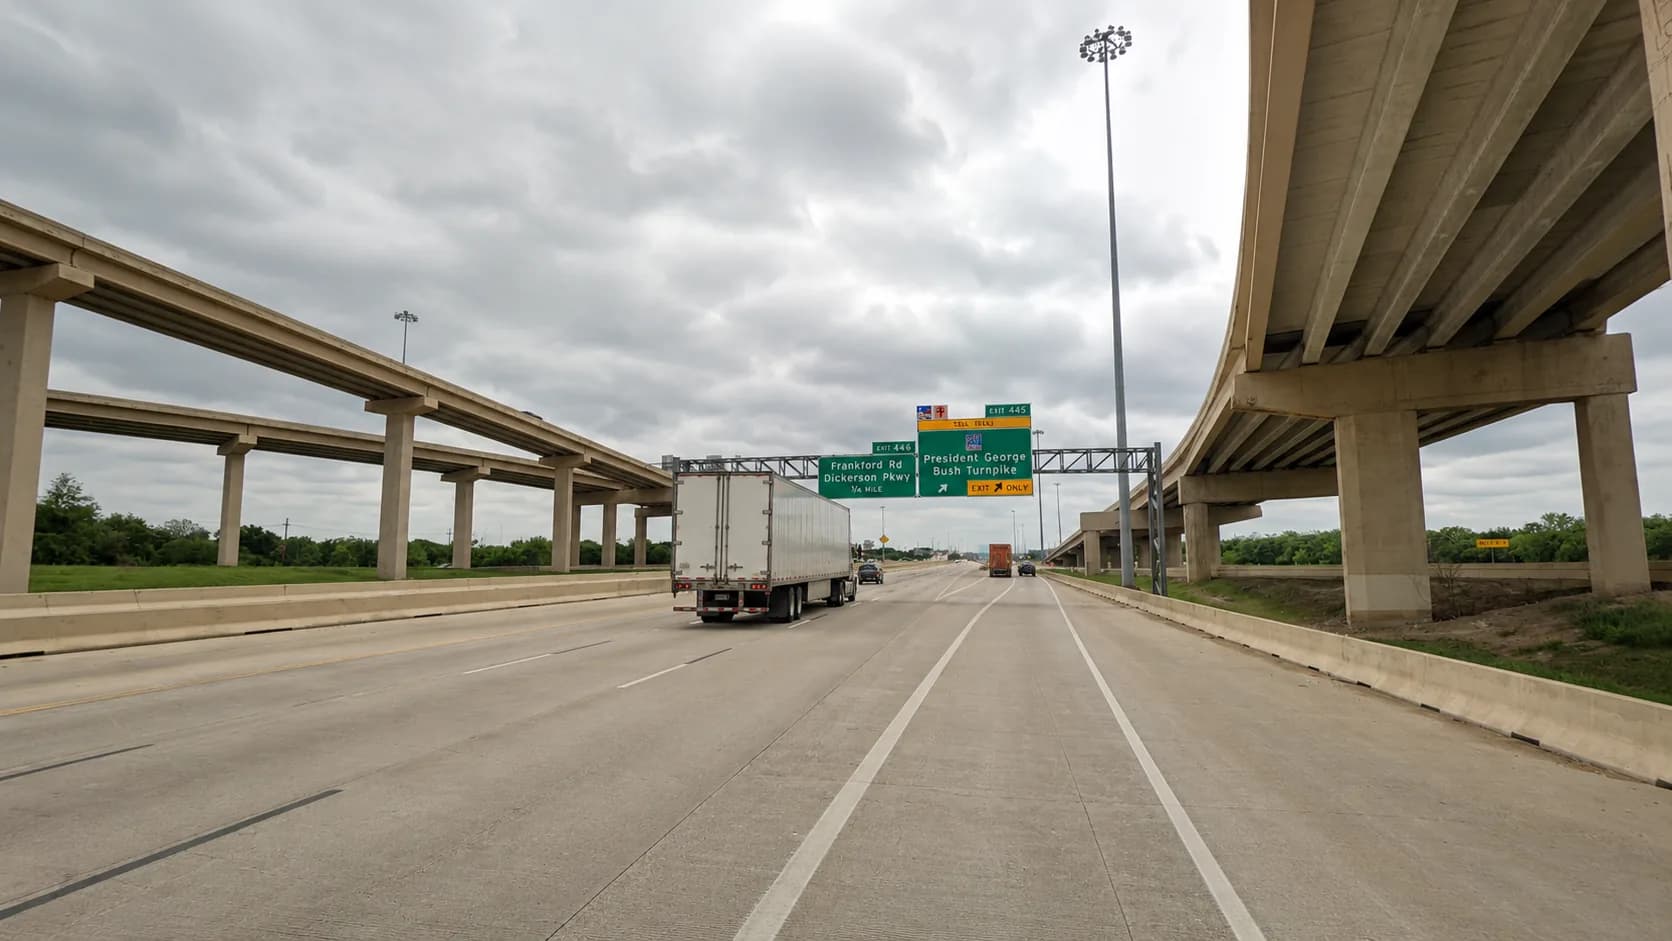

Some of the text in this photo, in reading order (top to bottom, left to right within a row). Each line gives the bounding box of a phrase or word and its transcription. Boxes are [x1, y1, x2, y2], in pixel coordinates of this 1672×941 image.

[1008, 406, 1026, 414] 445
[923, 452, 1026, 464] President George
[831, 460, 902, 470] Frankford Rd
[933, 464, 1017, 476] Bush Turnpike
[824, 473, 911, 483] Dickerson Pkwy
[971, 484, 990, 492] EXIT
